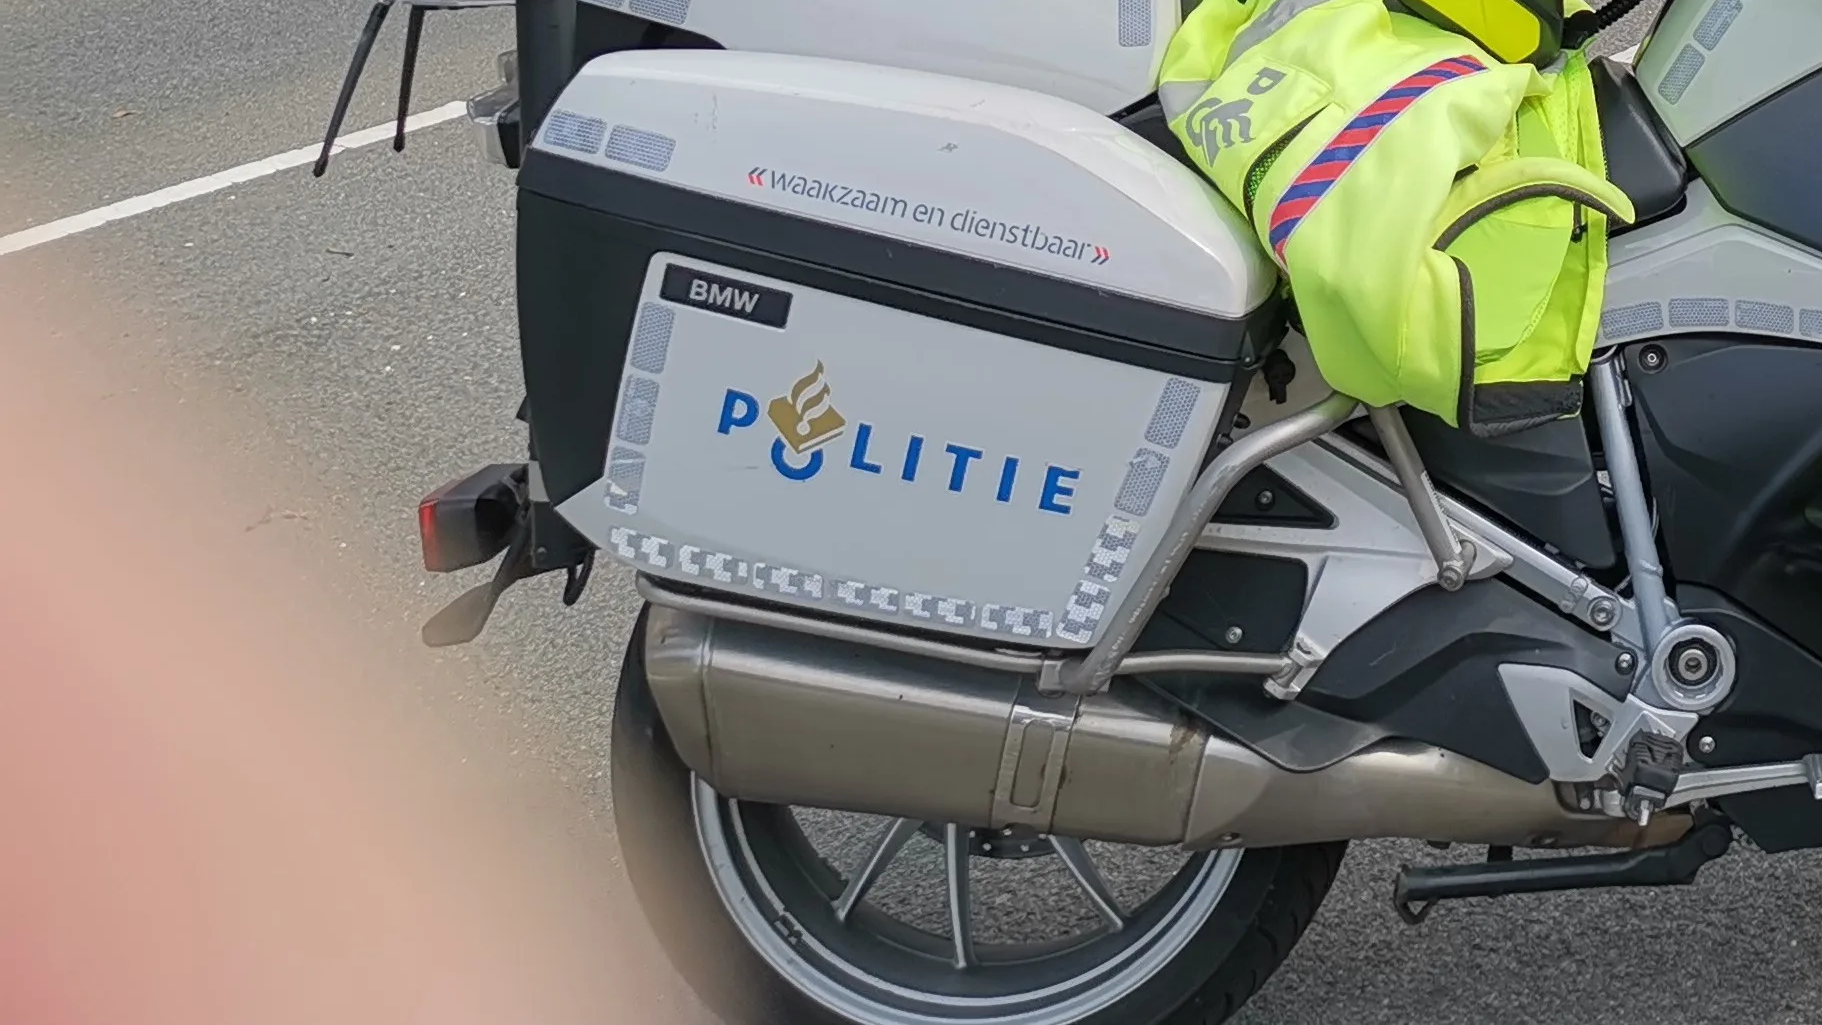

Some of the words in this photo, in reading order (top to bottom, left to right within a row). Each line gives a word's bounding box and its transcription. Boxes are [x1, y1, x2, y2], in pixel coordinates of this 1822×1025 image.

[913, 202, 944, 227] en
[689, 279, 760, 315] BMW
[717, 387, 1081, 515] POLITIE
